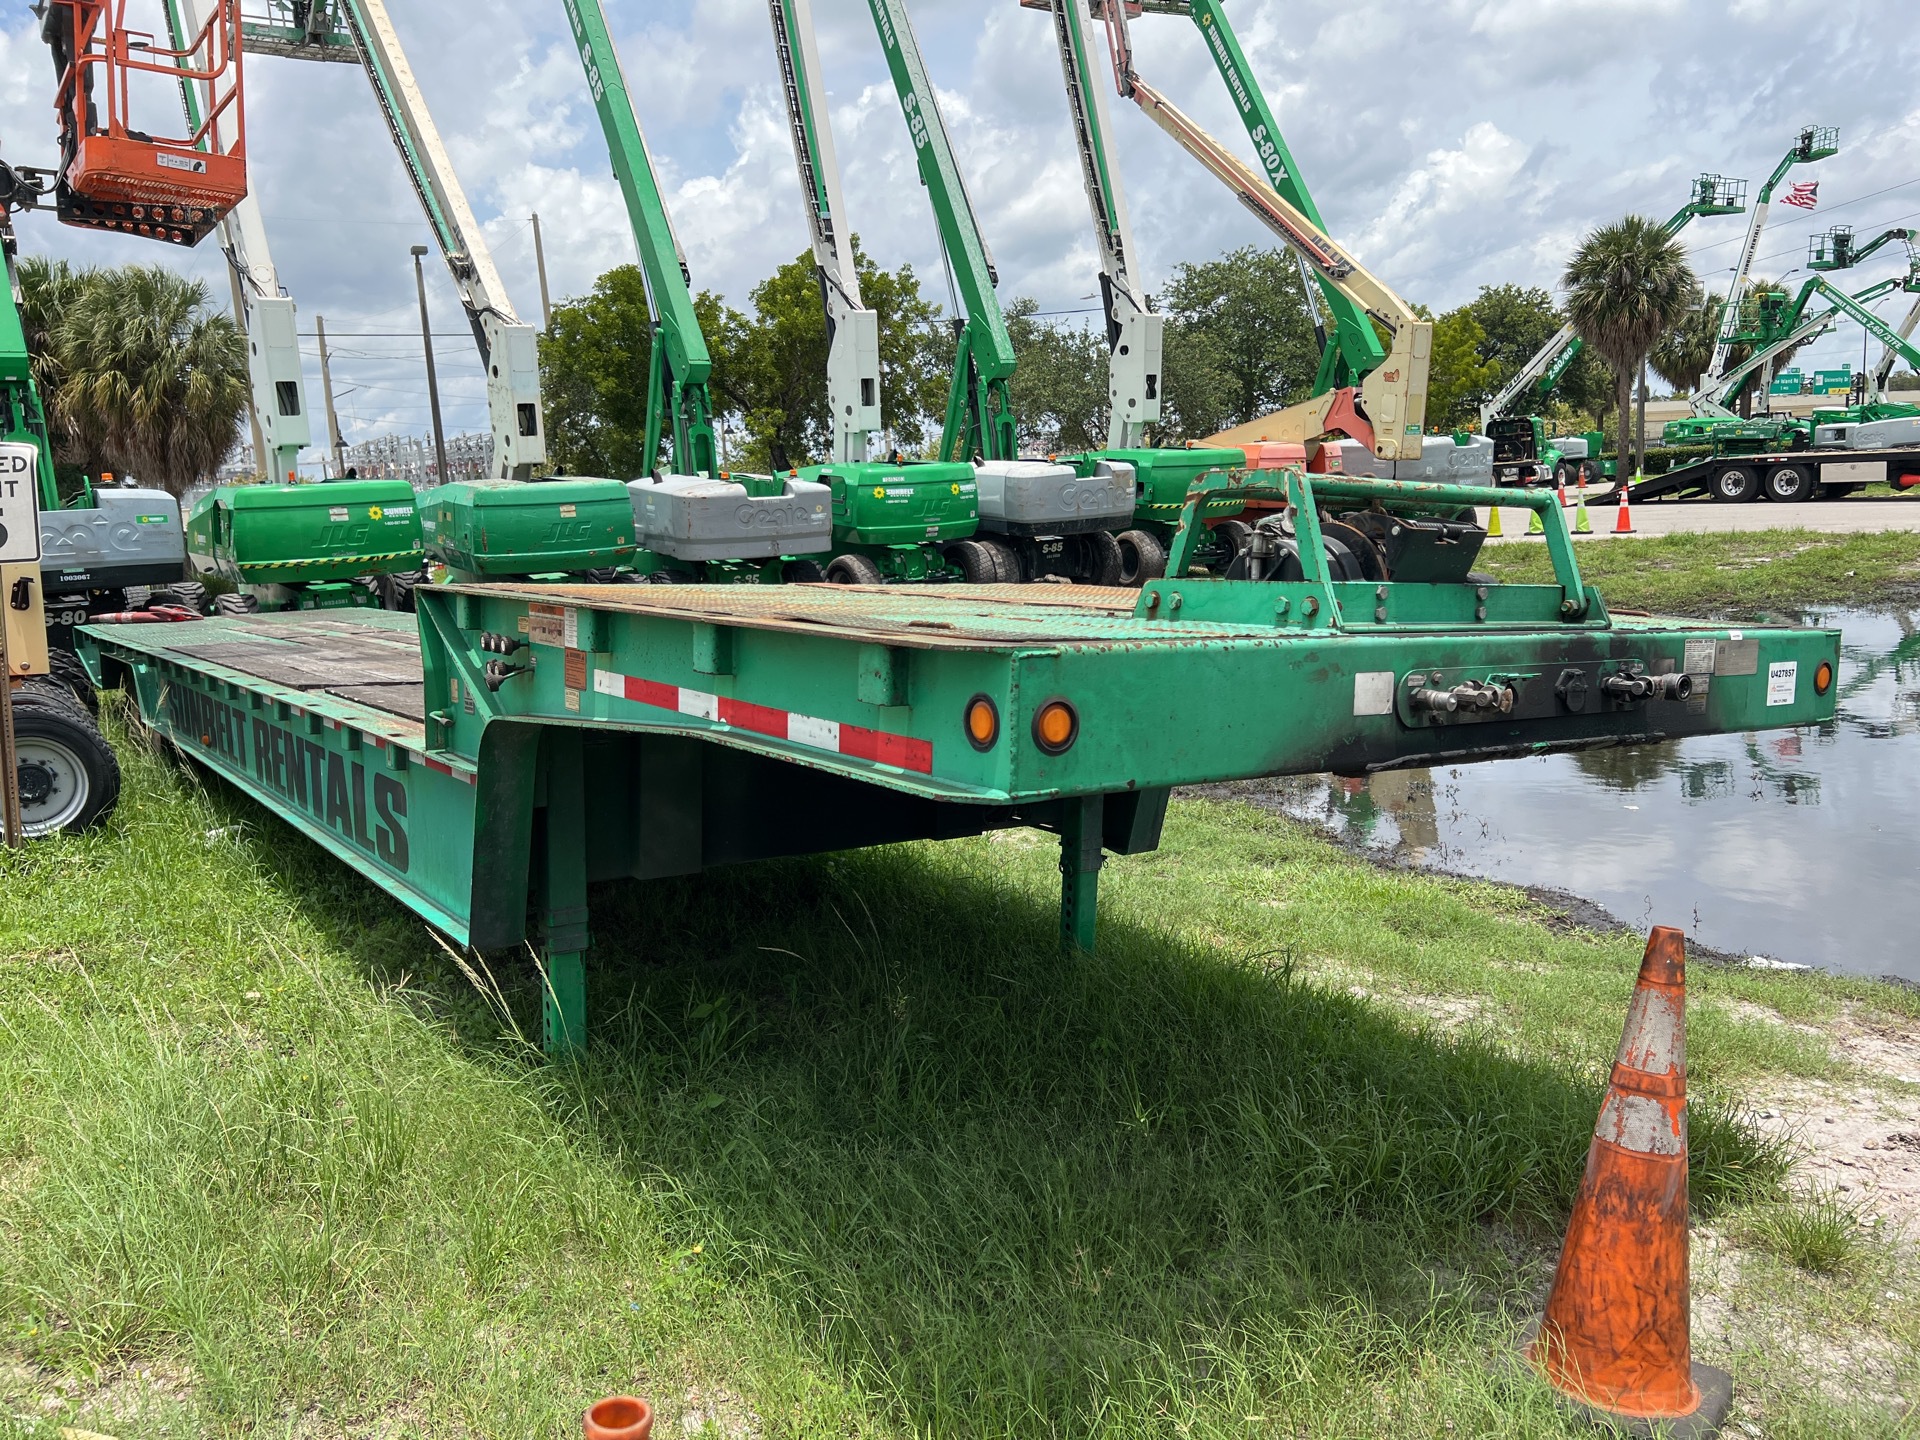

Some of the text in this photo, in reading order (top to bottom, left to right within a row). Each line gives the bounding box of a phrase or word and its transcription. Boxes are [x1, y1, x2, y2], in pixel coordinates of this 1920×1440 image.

[582, 43, 604, 102] S-85
[1207, 24, 1252, 113] SUNBELT RENTALS
[903, 92, 929, 149] S-85
[1547, 347, 1573, 380] Z-80/60
[885, 487, 915, 496] SUNBELT
[1057, 481, 1128, 512] Genie
[383, 506, 415, 516] SUNBELT
[734, 502, 810, 531] Genie
[311, 522, 370, 549] JLG
[541, 520, 593, 544] JLG
[1042, 542, 1064, 554] S-85
[45, 609, 87, 627] S-80
[1770, 668, 1796, 679] U427857
[166, 680, 409, 875] SUNBELT RENTALS
